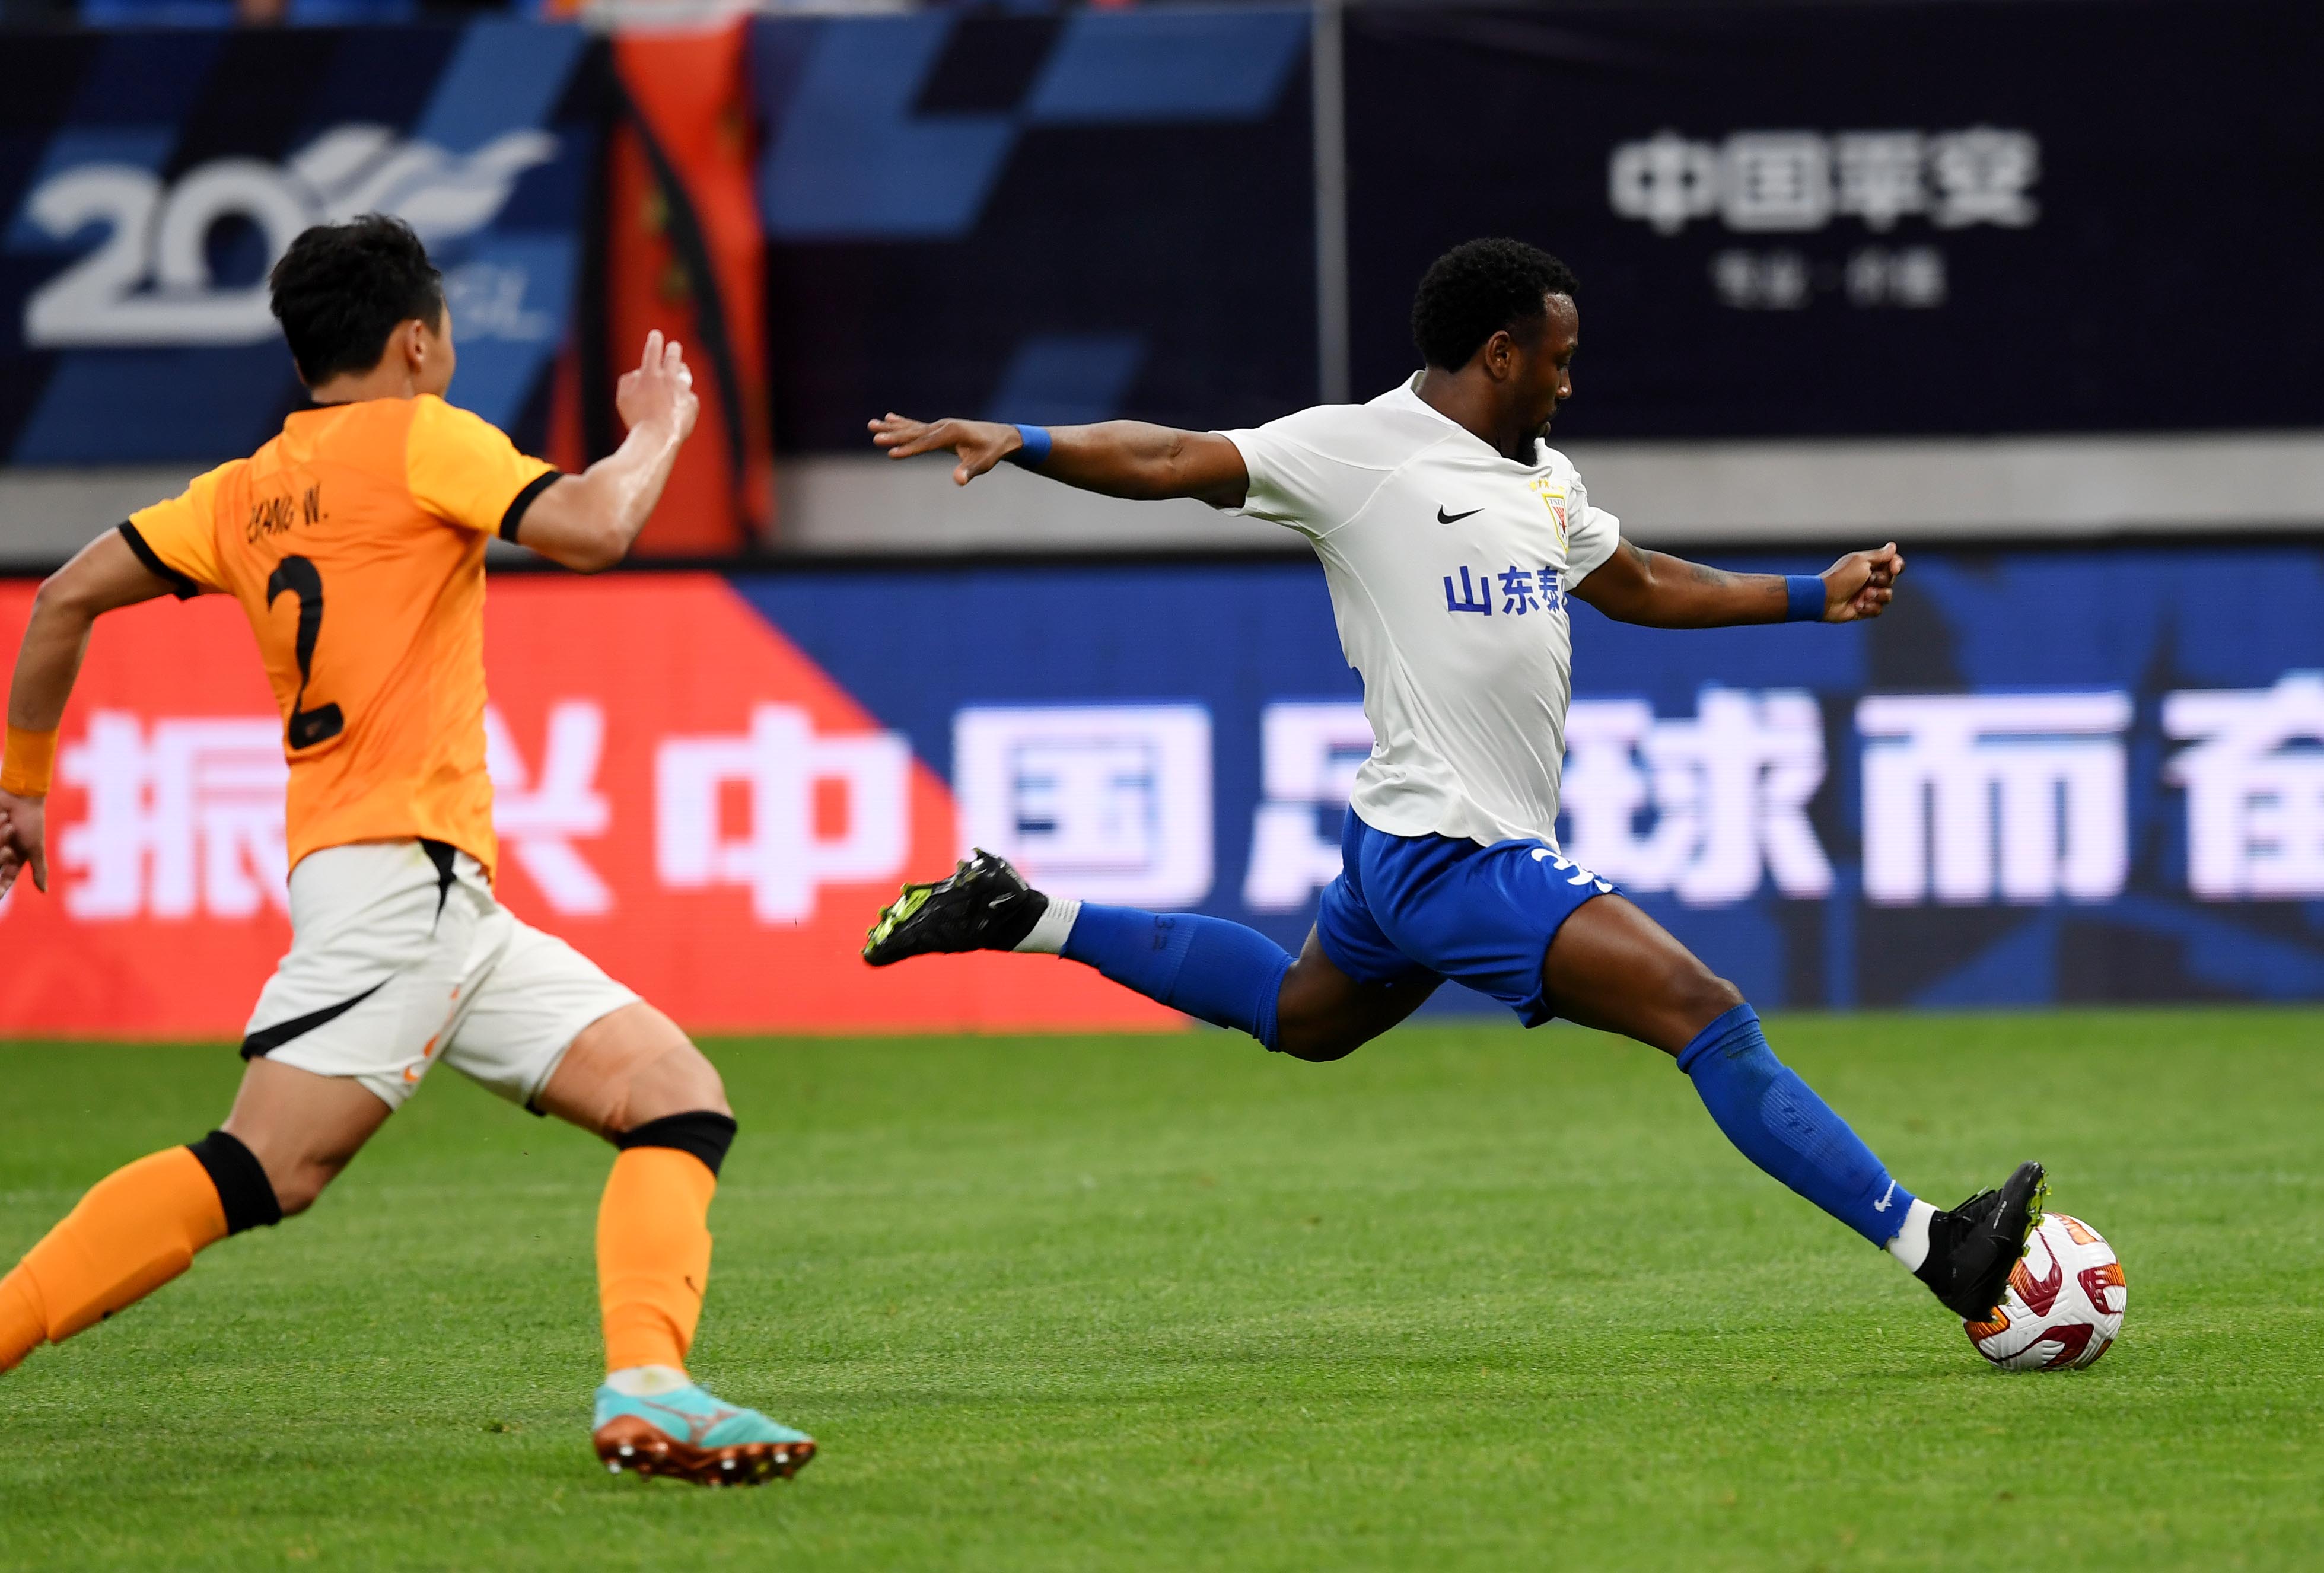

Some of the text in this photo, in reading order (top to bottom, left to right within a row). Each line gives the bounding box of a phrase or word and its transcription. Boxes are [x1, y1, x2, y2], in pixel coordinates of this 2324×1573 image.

[1606, 125, 2043, 236] 中国平安
[23, 153, 313, 349] 20
[1443, 565, 1567, 616] 山东泰
[266, 554, 345, 750] 2
[1530, 848, 1613, 893] 3
